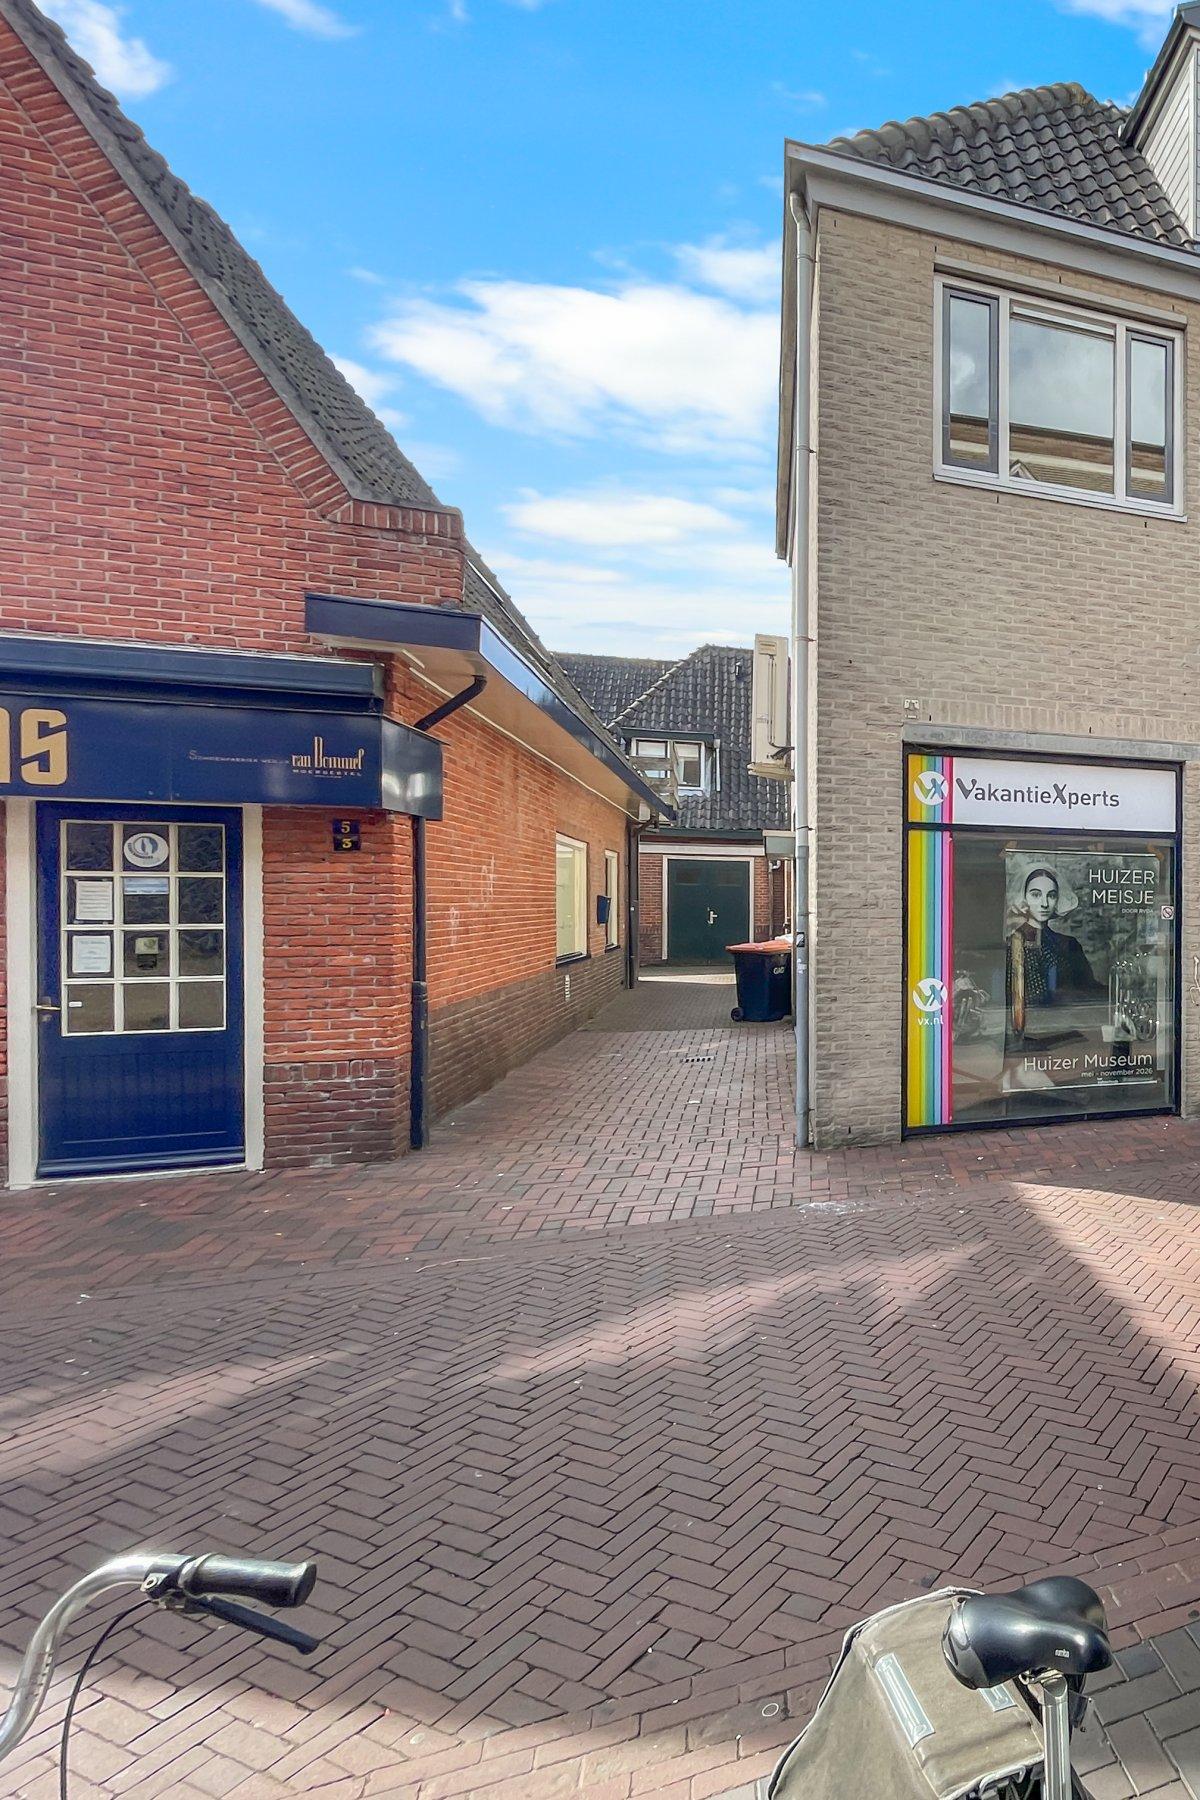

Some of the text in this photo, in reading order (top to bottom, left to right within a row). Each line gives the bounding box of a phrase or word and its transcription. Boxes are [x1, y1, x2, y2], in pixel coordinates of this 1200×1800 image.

[292, 736, 365, 770] van Bommel
[955, 777, 1120, 809] VakantieXperts
[340, 820, 351, 834] 5
[1089, 868, 1155, 885] HUIZER
[1092, 889, 1154, 905] MEISJE
[917, 1014, 944, 1026] vx.nl
[1024, 1054, 1153, 1071] Huizer Museum
[1100, 1068, 1135, 1077] november
